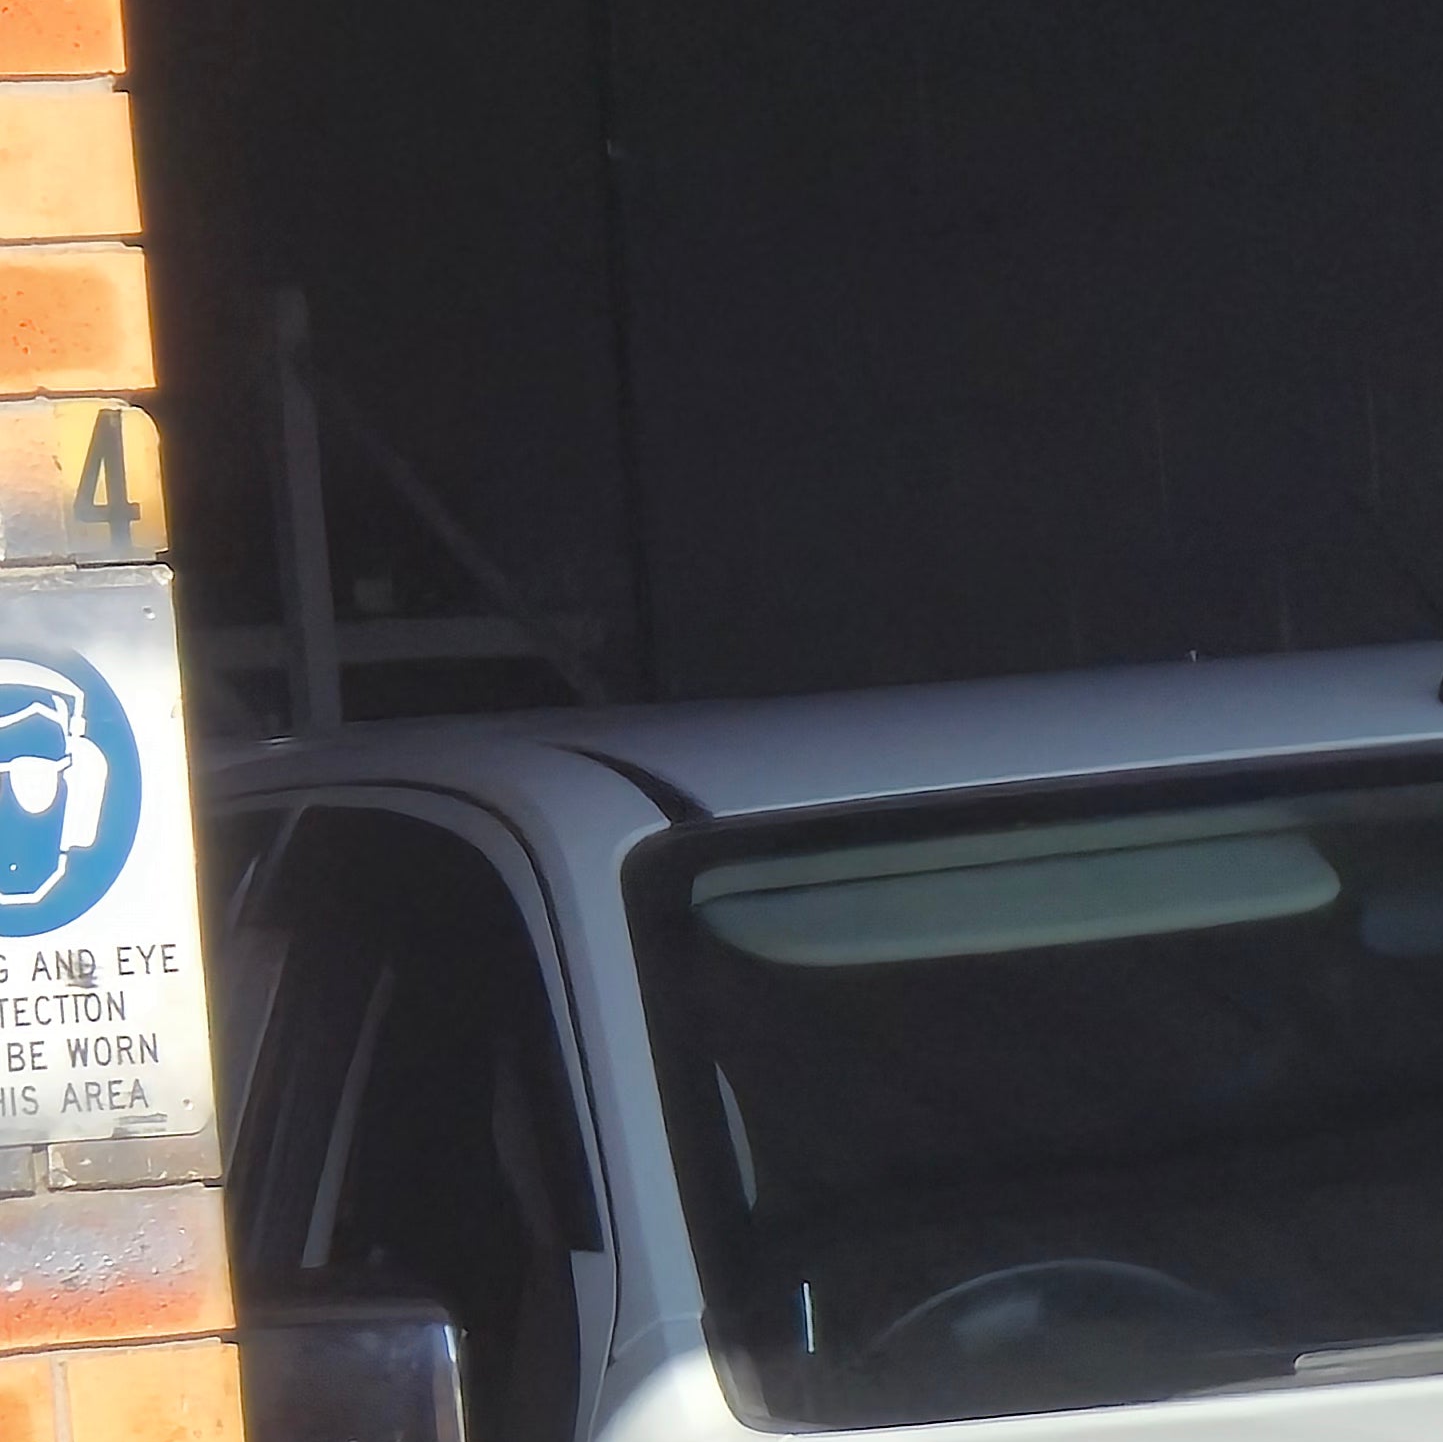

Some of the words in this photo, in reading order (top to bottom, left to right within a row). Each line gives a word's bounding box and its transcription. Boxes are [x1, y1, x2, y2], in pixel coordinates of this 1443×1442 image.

[73, 408, 141, 551] 4
[32, 948, 97, 981] AND
[117, 944, 179, 976] EYE
[7, 1041, 48, 1072] BE
[67, 1033, 159, 1069] WORN
[61, 1079, 149, 1114] AREA
